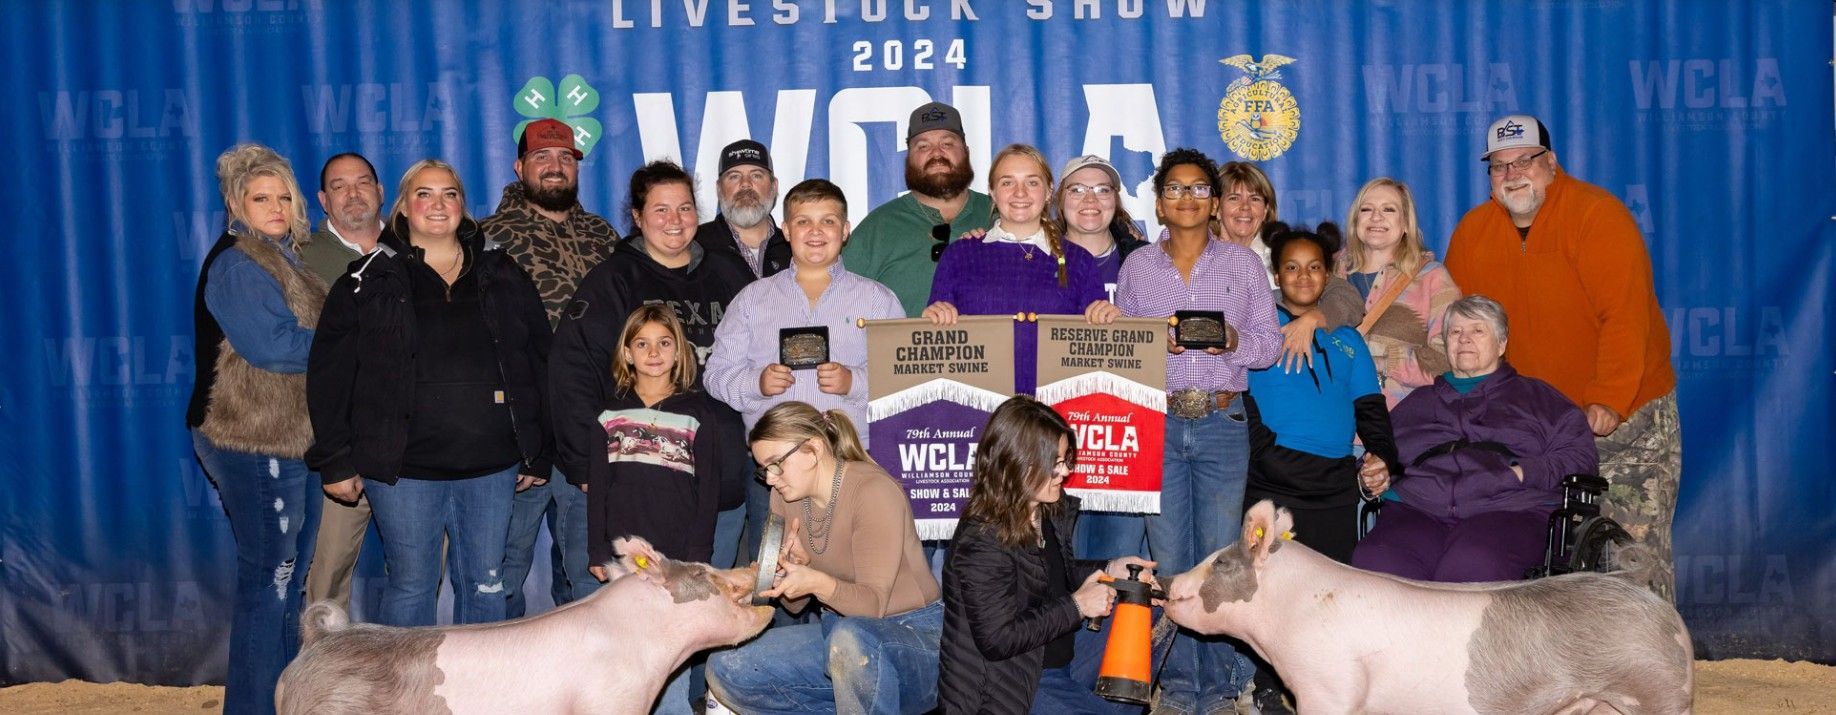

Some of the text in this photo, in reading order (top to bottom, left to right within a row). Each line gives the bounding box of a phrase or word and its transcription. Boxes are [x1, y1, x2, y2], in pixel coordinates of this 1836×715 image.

[612, 0, 1206, 28] LIVESTOCK SHOW
[852, 38, 966, 71] 2024
[1362, 63, 1519, 113] WCLA
[1629, 58, 1787, 109] WCLA
[38, 88, 200, 140] WCLA
[302, 82, 456, 133] WCLA
[1244, 100, 1275, 113] FFA
[633, 84, 1171, 240] WCLA
[643, 299, 725, 326] EXA
[912, 330, 969, 346] GRAND
[1051, 327, 1154, 344] RESERVE GRAND
[896, 345, 985, 362] CHAMPION
[1069, 342, 1135, 357] CHAMPION
[44, 335, 197, 387] WCLA
[894, 362, 989, 375] MARKET SWINE
[1061, 357, 1142, 369] MARKET SWINE
[1068, 410, 1133, 423] 79th Annual
[906, 426, 977, 439] 79th Annual
[898, 443, 979, 472] WCLA
[1109, 451, 1138, 459] COUNTY
[1098, 464, 1105, 475] &
[1107, 465, 1129, 476] SALE
[1086, 475, 1110, 484] 2024
[910, 488, 970, 499] SHOW & SAL
[930, 502, 956, 513] 2024
